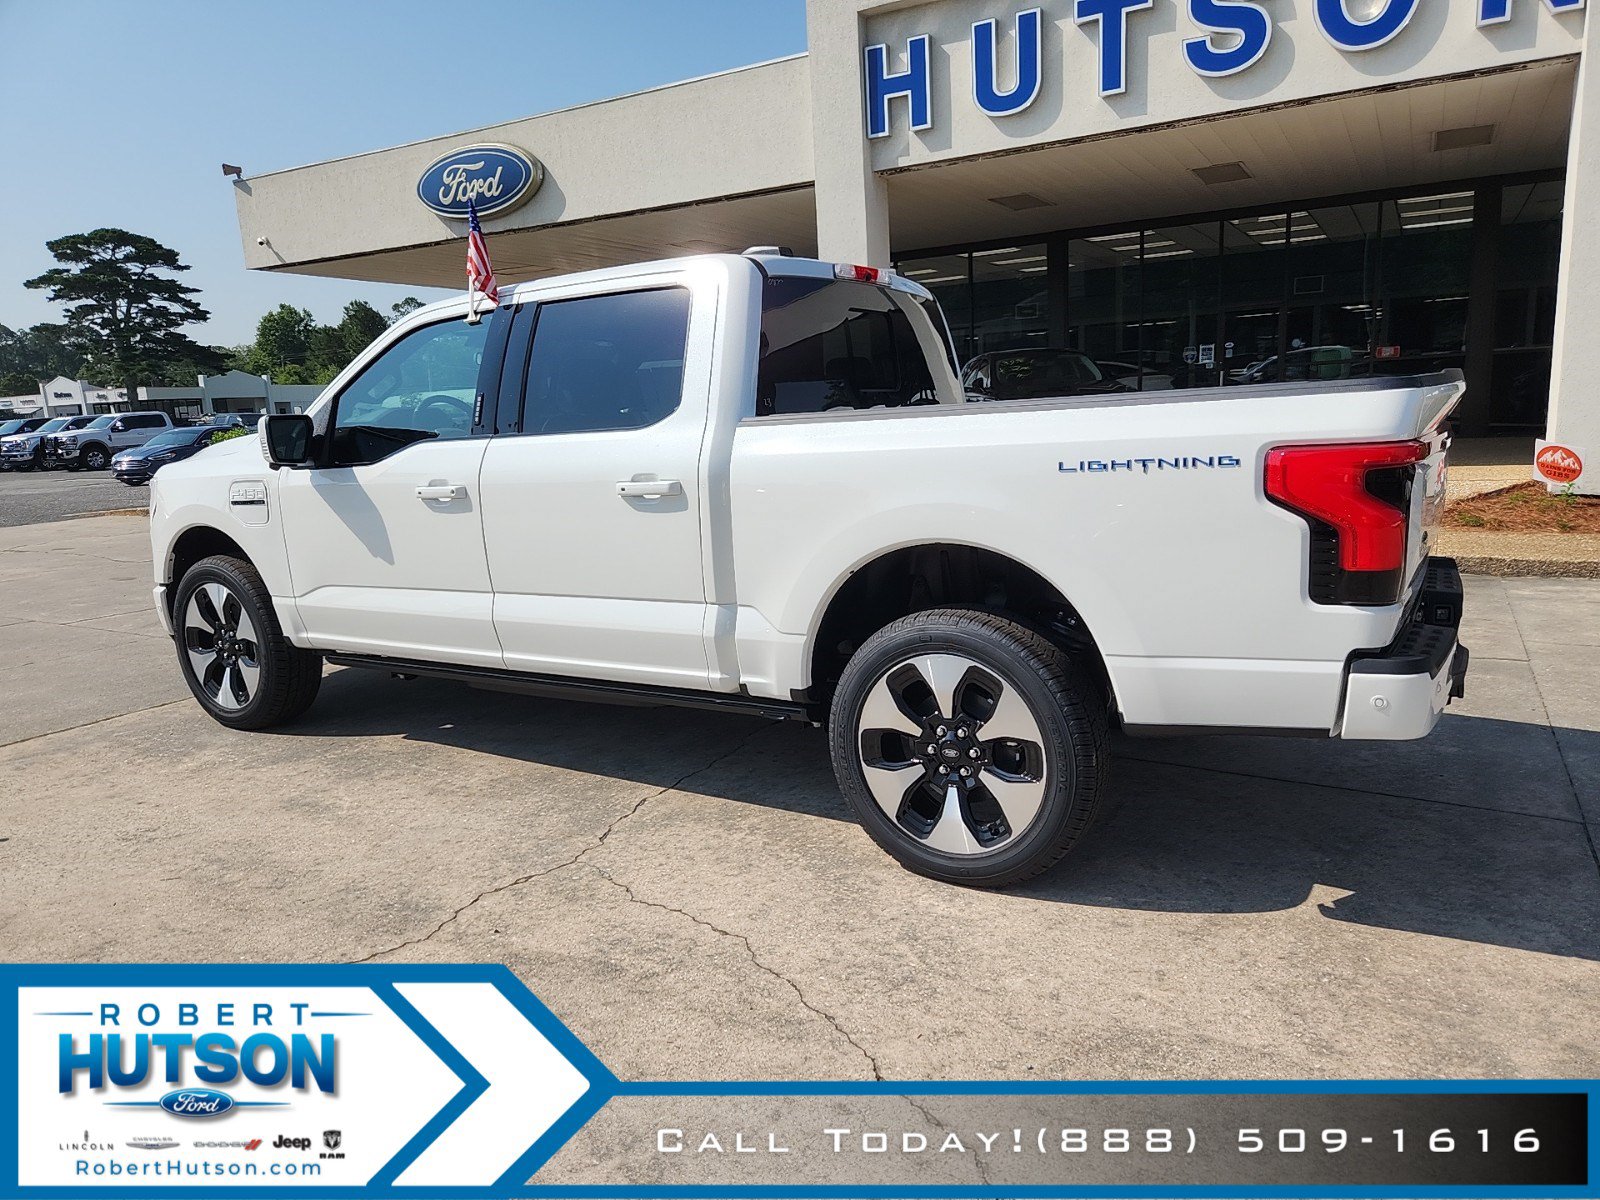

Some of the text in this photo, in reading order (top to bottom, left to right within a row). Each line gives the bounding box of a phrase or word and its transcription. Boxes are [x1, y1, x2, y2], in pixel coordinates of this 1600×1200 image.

[864, 0, 1584, 138] HUTS
[439, 160, 503, 205] Ford
[1058, 455, 1242, 475] LIGHTNING
